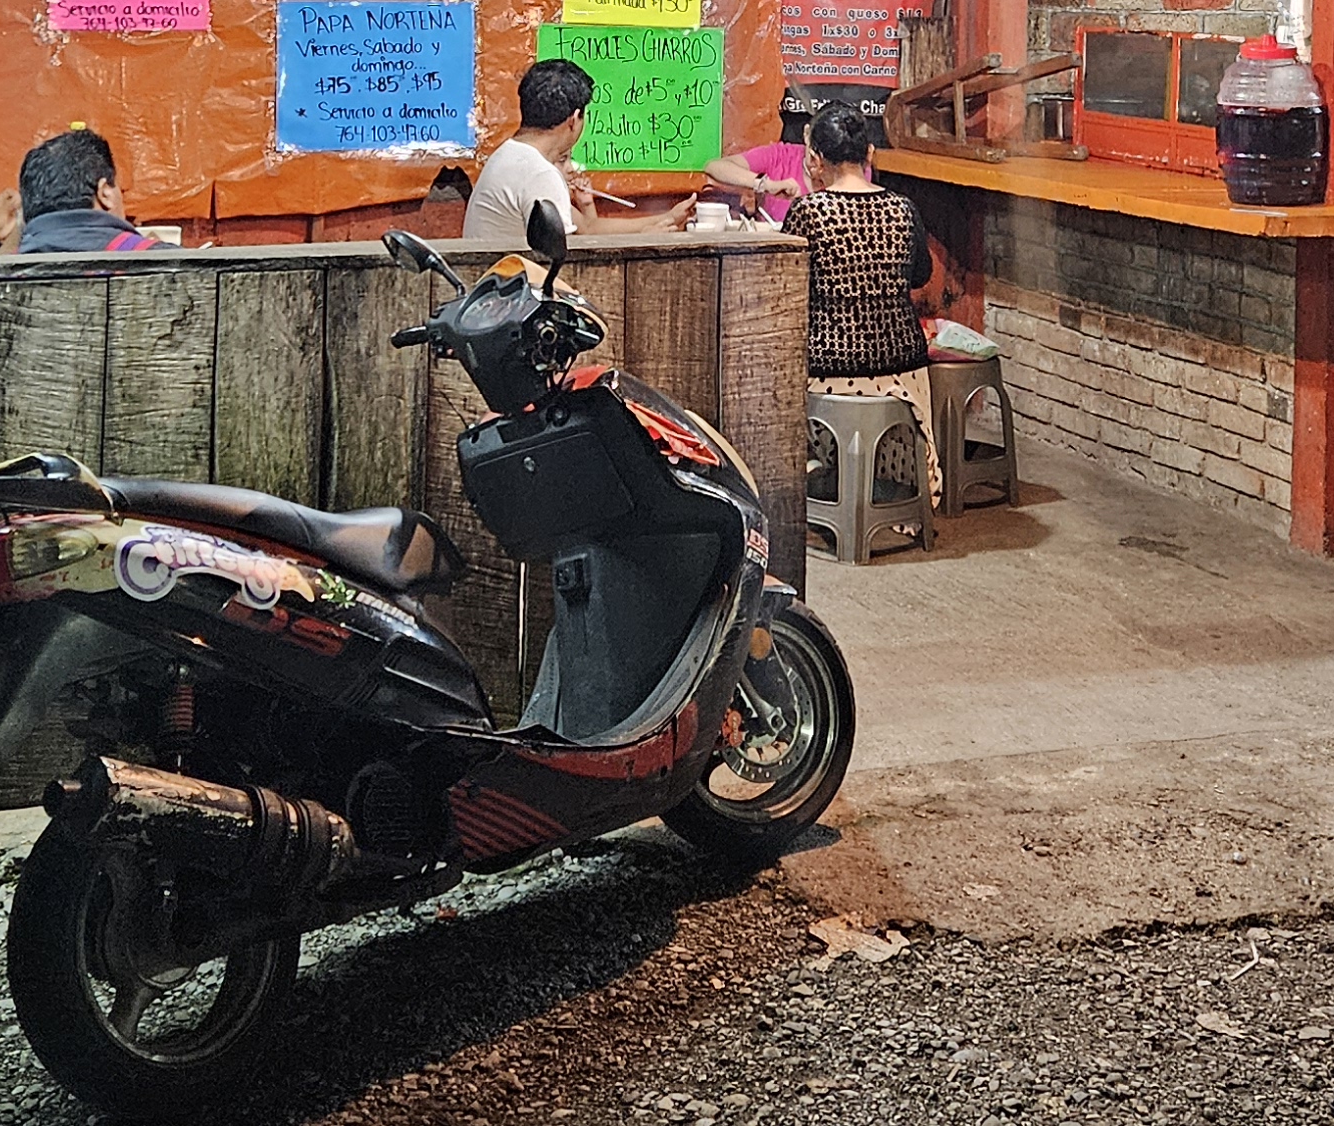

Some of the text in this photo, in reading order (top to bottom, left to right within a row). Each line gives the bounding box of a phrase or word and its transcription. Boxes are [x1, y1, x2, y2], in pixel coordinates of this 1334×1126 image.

[57, 0, 200, 17] Servicio a domicilio
[813, 7, 837, 17] con
[848, 9, 888, 21] queso
[298, 4, 457, 34] PAPA NORTEÑA
[432, 41, 440, 55] y
[812, 43, 868, 60] Sábado y
[795, 62, 897, 75] Norteña con Carne
[624, 76, 645, 105] de
[318, 101, 458, 120] Servicio a domicilio
